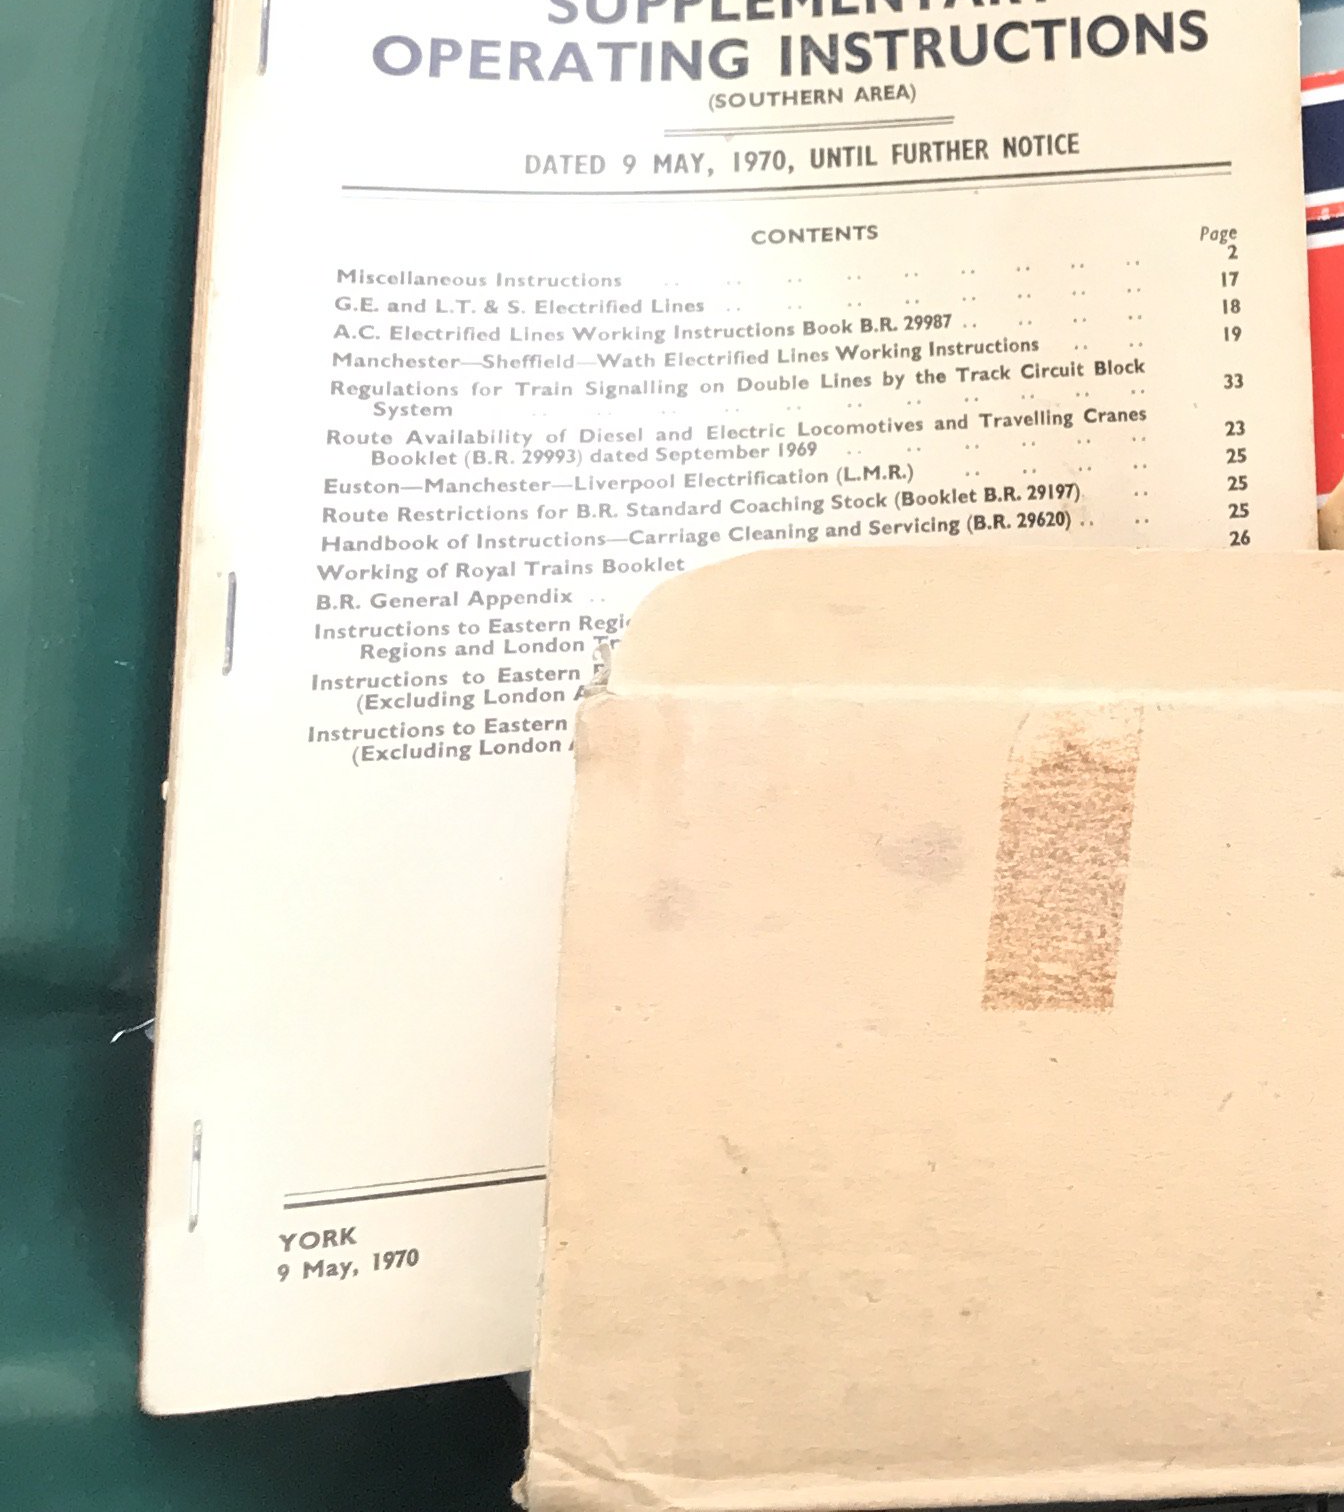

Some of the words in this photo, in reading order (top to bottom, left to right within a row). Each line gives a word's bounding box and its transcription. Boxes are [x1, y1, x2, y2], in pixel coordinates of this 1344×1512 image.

[373, 35, 748, 81] OPERATING
[781, 9, 1207, 76] INSTRUCTIONS
[709, 88, 842, 111] (SOUTHERN
[854, 84, 915, 103] AREA)
[525, 154, 605, 174] DATED
[623, 154, 635, 173] 9
[654, 153, 713, 176] MAY,
[734, 150, 793, 173] 1970,
[810, 145, 877, 168] UNTIL
[892, 139, 988, 164] FURTHER
[1003, 133, 1079, 158] NOTICE
[751, 225, 877, 244] CONTENTS
[1200, 226, 1236, 244] Page
[337, 269, 486, 286] Miscellaneous
[496, 272, 620, 286] Instructions
[1227, 245, 1239, 259] 2
[335, 296, 378, 312] G.E.
[387, 298, 425, 312] and
[436, 298, 475, 313] L.T.
[484, 299, 497, 313] &
[508, 300, 524, 313] S.
[535, 299, 641, 313] Electrified
[651, 298, 703, 312] Lines
[1221, 271, 1238, 286] 17
[333, 324, 379, 339] A.C.
[390, 325, 499, 340] Electrified
[510, 327, 563, 340] Lines
[572, 326, 665, 343] Working
[674, 322, 794, 338] Instructions
[803, 319, 851, 335] Book
[860, 317, 897, 332] B.R.
[903, 313, 951, 330] 29987
[1223, 298, 1240, 314] 18
[332, 352, 654, 368] Manchester—Sheffield—Wath
[664, 349, 768, 366] Electrified
[778, 348, 828, 362] Lines
[835, 343, 921, 361] Working
[929, 337, 1038, 356] Instructions
[1224, 326, 1241, 341] 19
[324, 474, 673, 493] Euston—Manchester—Liverpool
[684, 468, 827, 487] Electrification
[836, 463, 913, 485] (L.M.R.)
[316, 594, 360, 609] B.R.
[370, 591, 457, 608] General
[467, 588, 571, 609] Appendix
[278, 1226, 357, 1252] YORK
[277, 1264, 290, 1282] 9
[302, 1259, 359, 1280] May,
[373, 1248, 419, 1271] 1970
